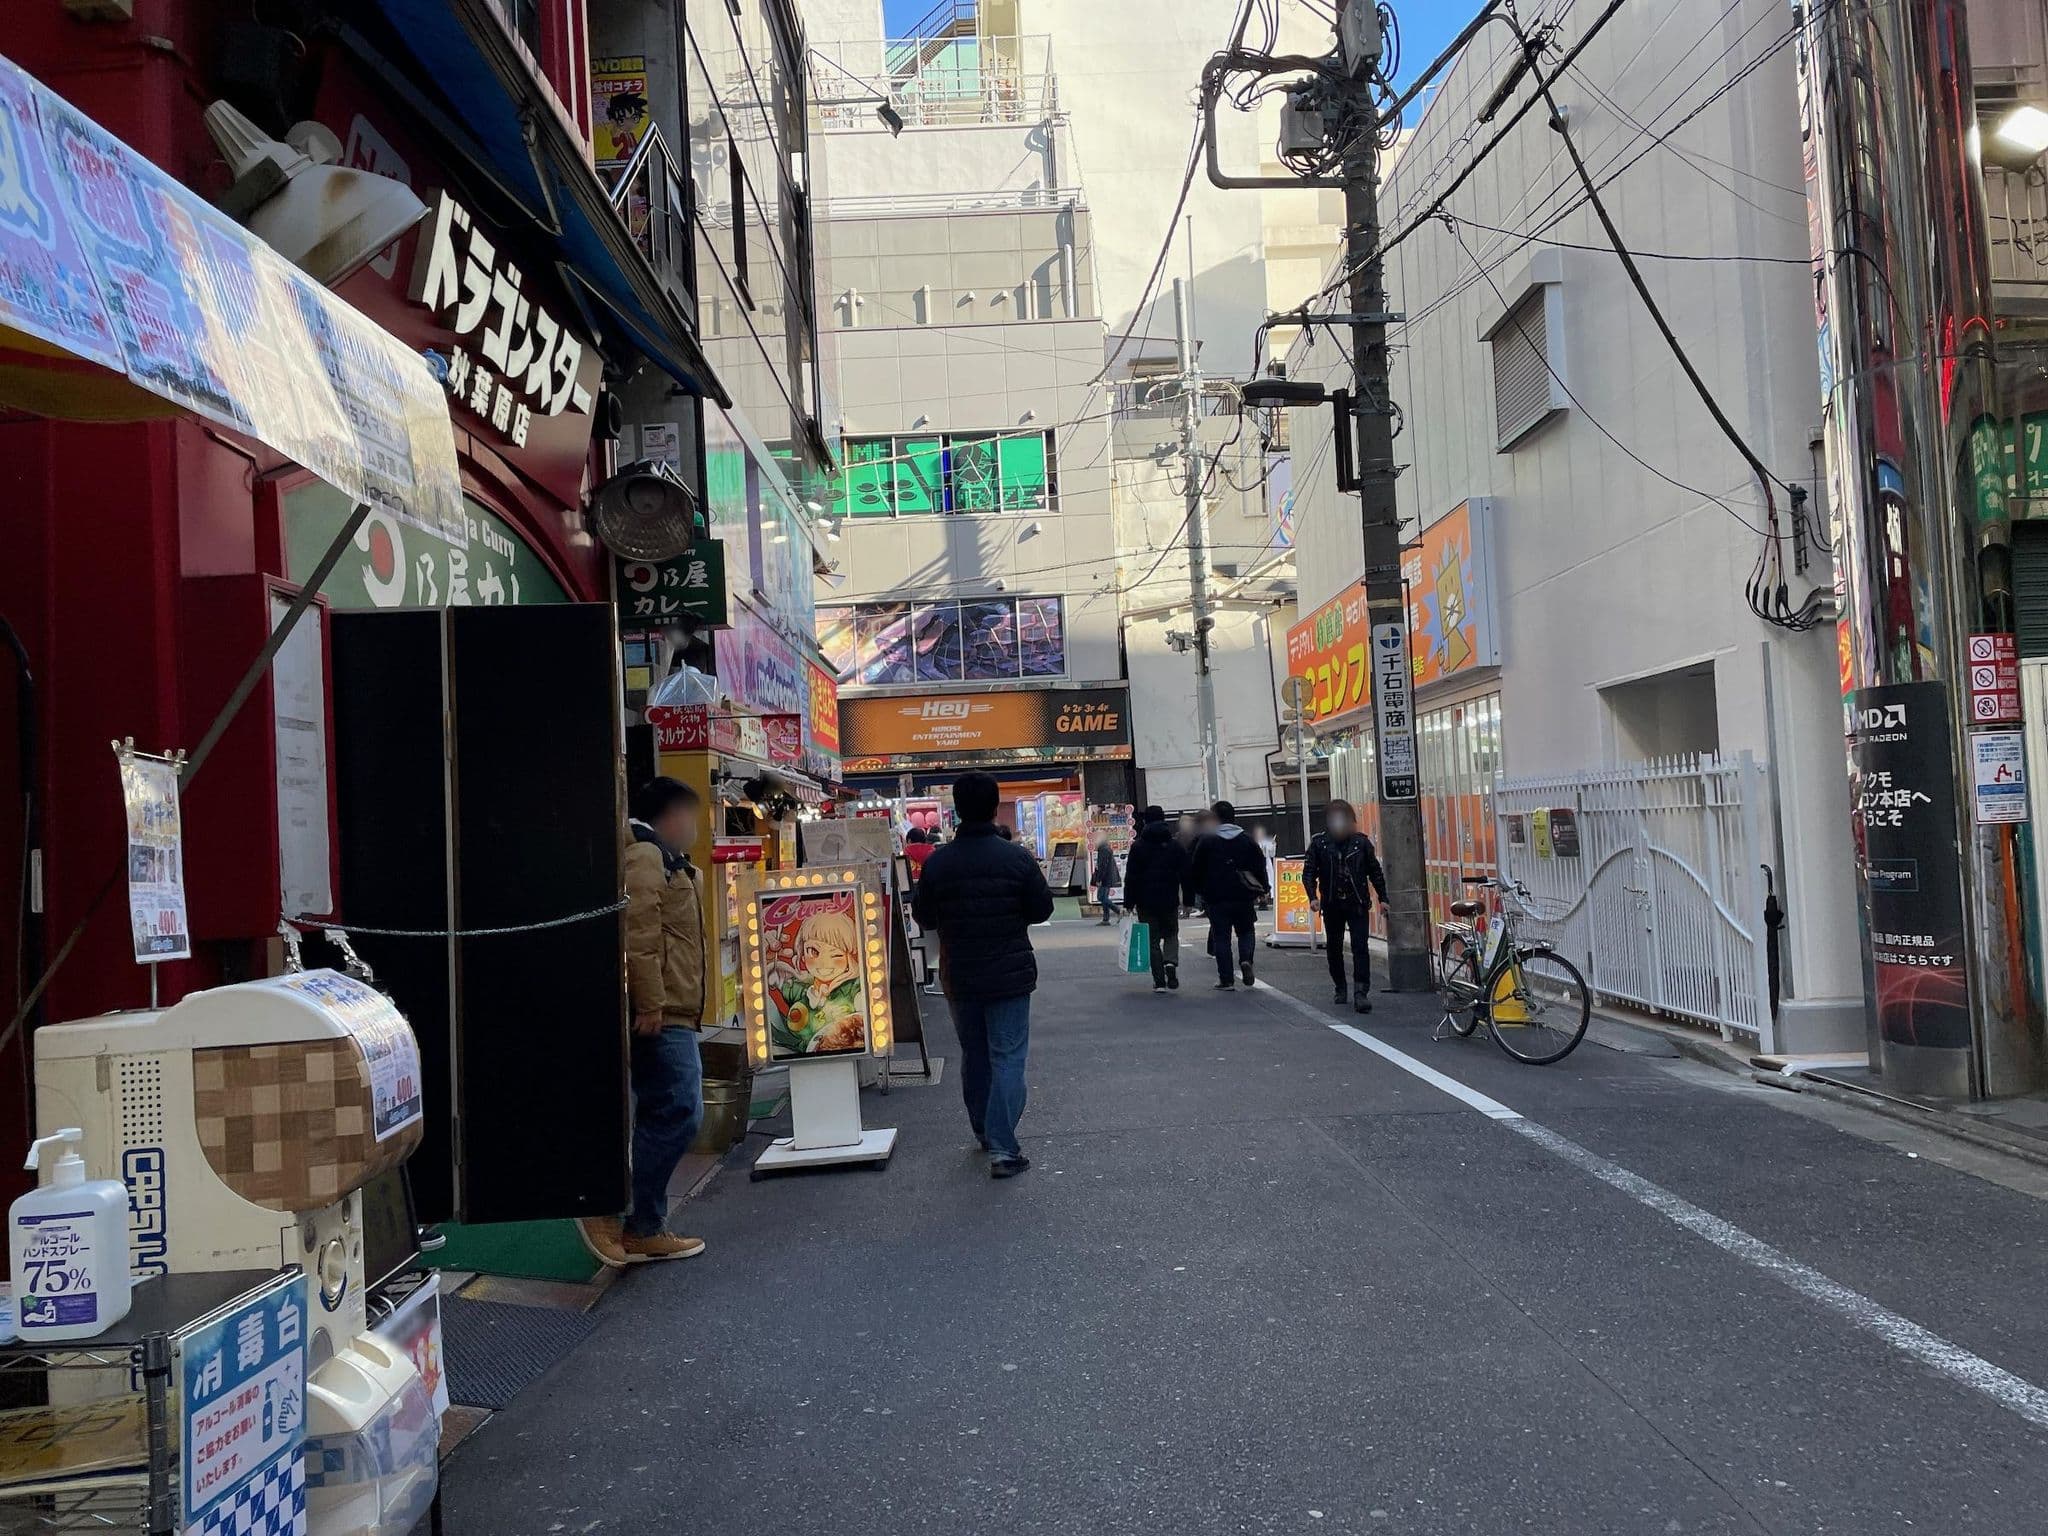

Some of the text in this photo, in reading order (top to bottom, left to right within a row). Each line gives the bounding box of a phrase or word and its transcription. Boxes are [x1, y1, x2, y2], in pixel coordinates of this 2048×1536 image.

[422, 188, 592, 416] ドラゴンスター
[449, 345, 531, 449] 秋葉原店
[482, 519, 515, 566] Curry
[634, 595, 709, 614] カレー
[1382, 653, 1406, 728] 千石電商
[921, 700, 970, 720] Hey
[1056, 713, 1118, 733] GAME
[912, 731, 982, 741] ENTERTAINMENT
[1870, 732, 1908, 743] RADEON
[1280, 885, 1298, 894] PC
[1879, 869, 1911, 881] Program
[23, 1246, 91, 1259] ハンドスプレー
[23, 1259, 91, 1294] 75%
[192, 1293, 300, 1401] 消毒台
[195, 1384, 260, 1438] アルコール消毒の
[196, 1414, 256, 1466] ご協力をお願い
[195, 1453, 243, 1494] いたします。
